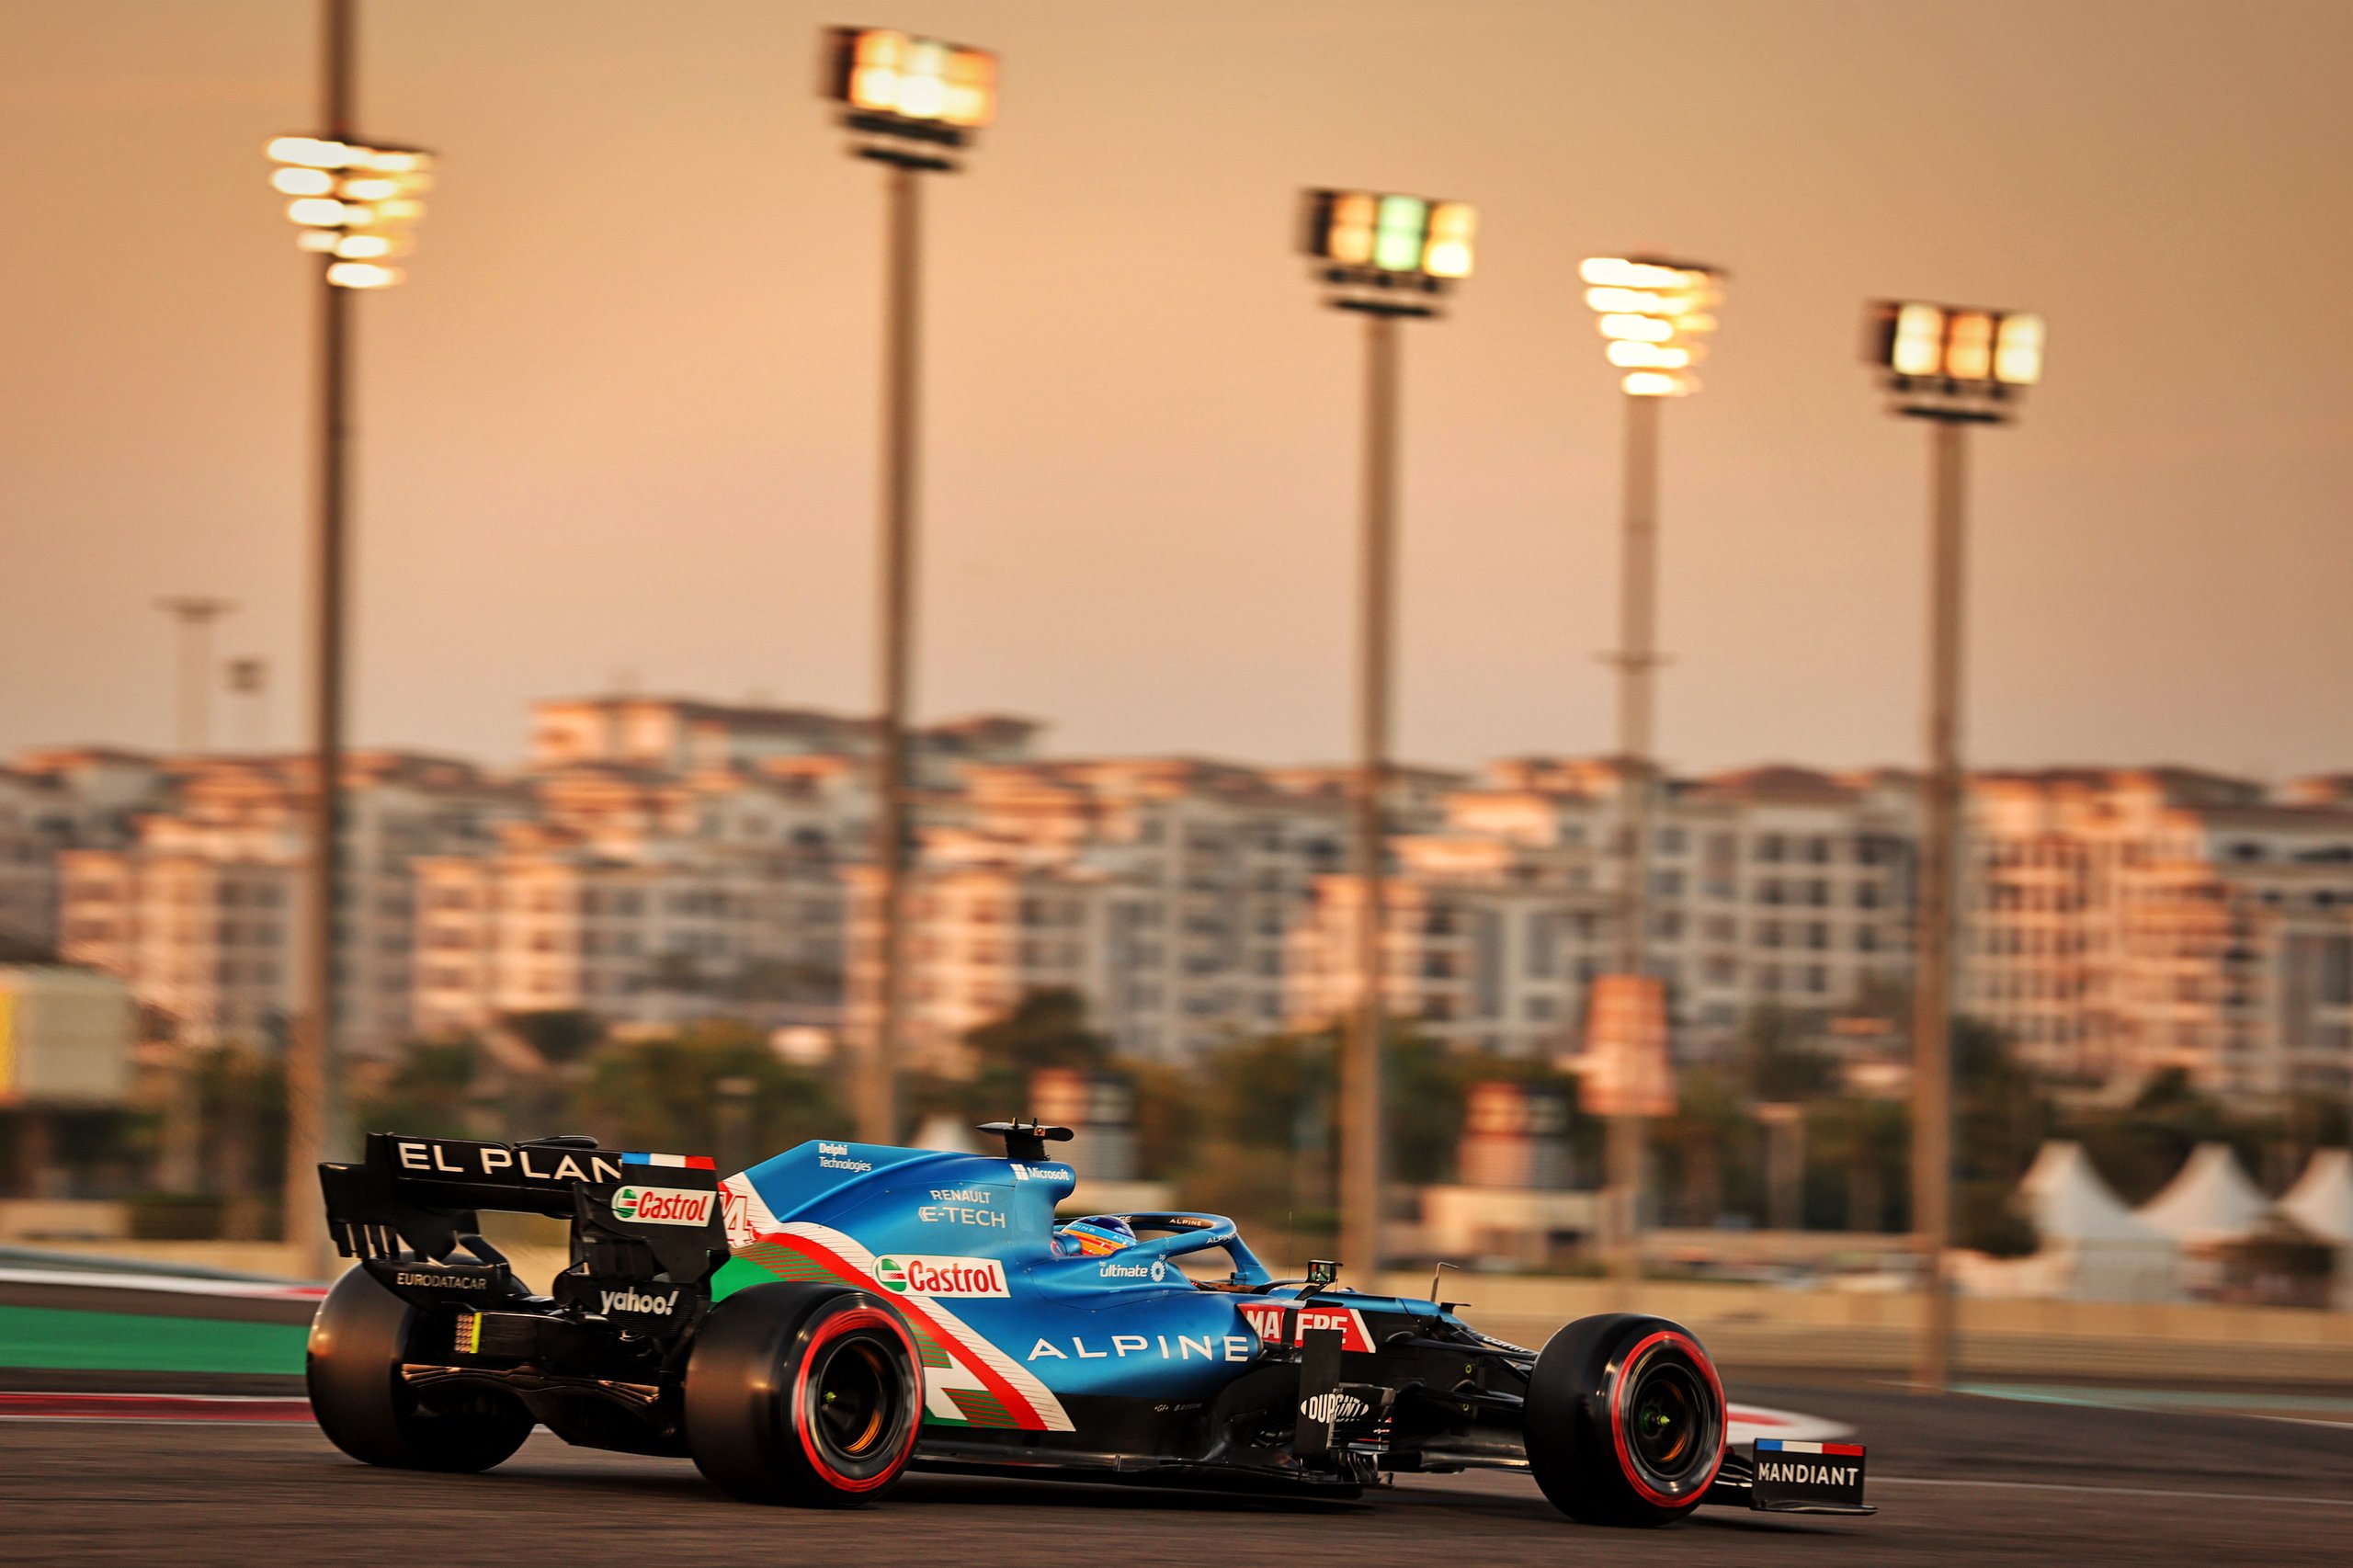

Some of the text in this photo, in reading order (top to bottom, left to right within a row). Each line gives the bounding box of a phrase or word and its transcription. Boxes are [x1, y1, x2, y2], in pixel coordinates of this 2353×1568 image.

[818, 1142, 847, 1156] Delphi
[397, 1142, 622, 1183] EL PLAN
[818, 1156, 871, 1172] Technologies
[1028, 1167, 1070, 1181] Microsoft
[638, 1191, 709, 1221] Castrol
[929, 1189, 991, 1204] RENAULT
[918, 1206, 1006, 1229] E-TECH
[1169, 1218, 1202, 1227] ALPINE
[396, 1272, 487, 1290] EURODATACAR
[907, 1260, 1000, 1293] Castrol
[1099, 1264, 1148, 1278] ultimate
[600, 1288, 680, 1315] yahoo!
[1245, 1310, 1348, 1344] MAFRE
[1027, 1335, 1250, 1363] ALPINE
[1757, 1461, 1860, 1486] MANDIANT
